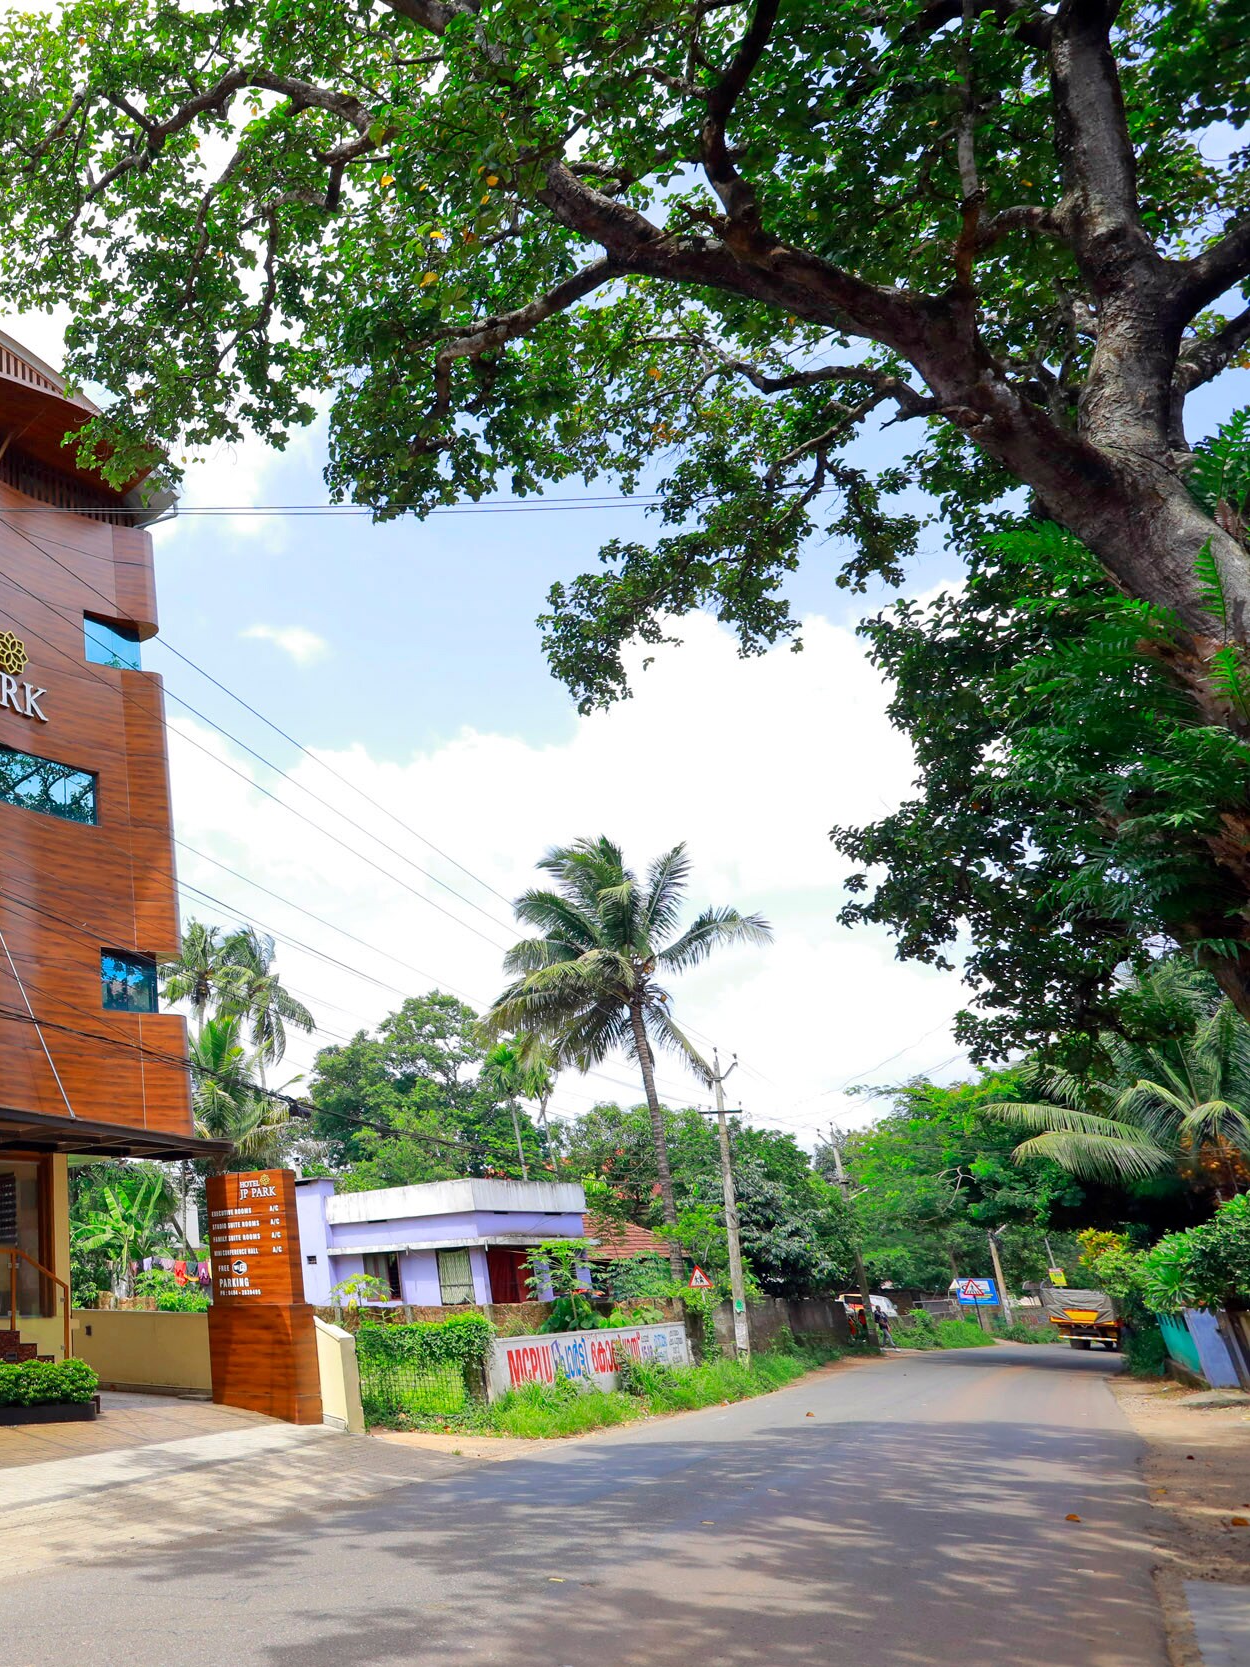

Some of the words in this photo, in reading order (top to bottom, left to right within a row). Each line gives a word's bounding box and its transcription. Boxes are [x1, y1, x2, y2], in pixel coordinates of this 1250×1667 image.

[239, 1180, 260, 1189] HOTEL
[239, 1189, 249, 1200] JP
[251, 1186, 277, 1198] PARK
[211, 1209, 234, 1217] EXECUTIVE
[234, 1207, 252, 1215] ROOMS
[227, 1221, 241, 1229] SUITE
[228, 1234, 242, 1242] SUITE
[271, 1231, 281, 1239] A/C
[222, 1248, 247, 1256] CONFERENCE
[218, 1264, 230, 1272] FREE
[219, 1277, 250, 1288] PARKING
